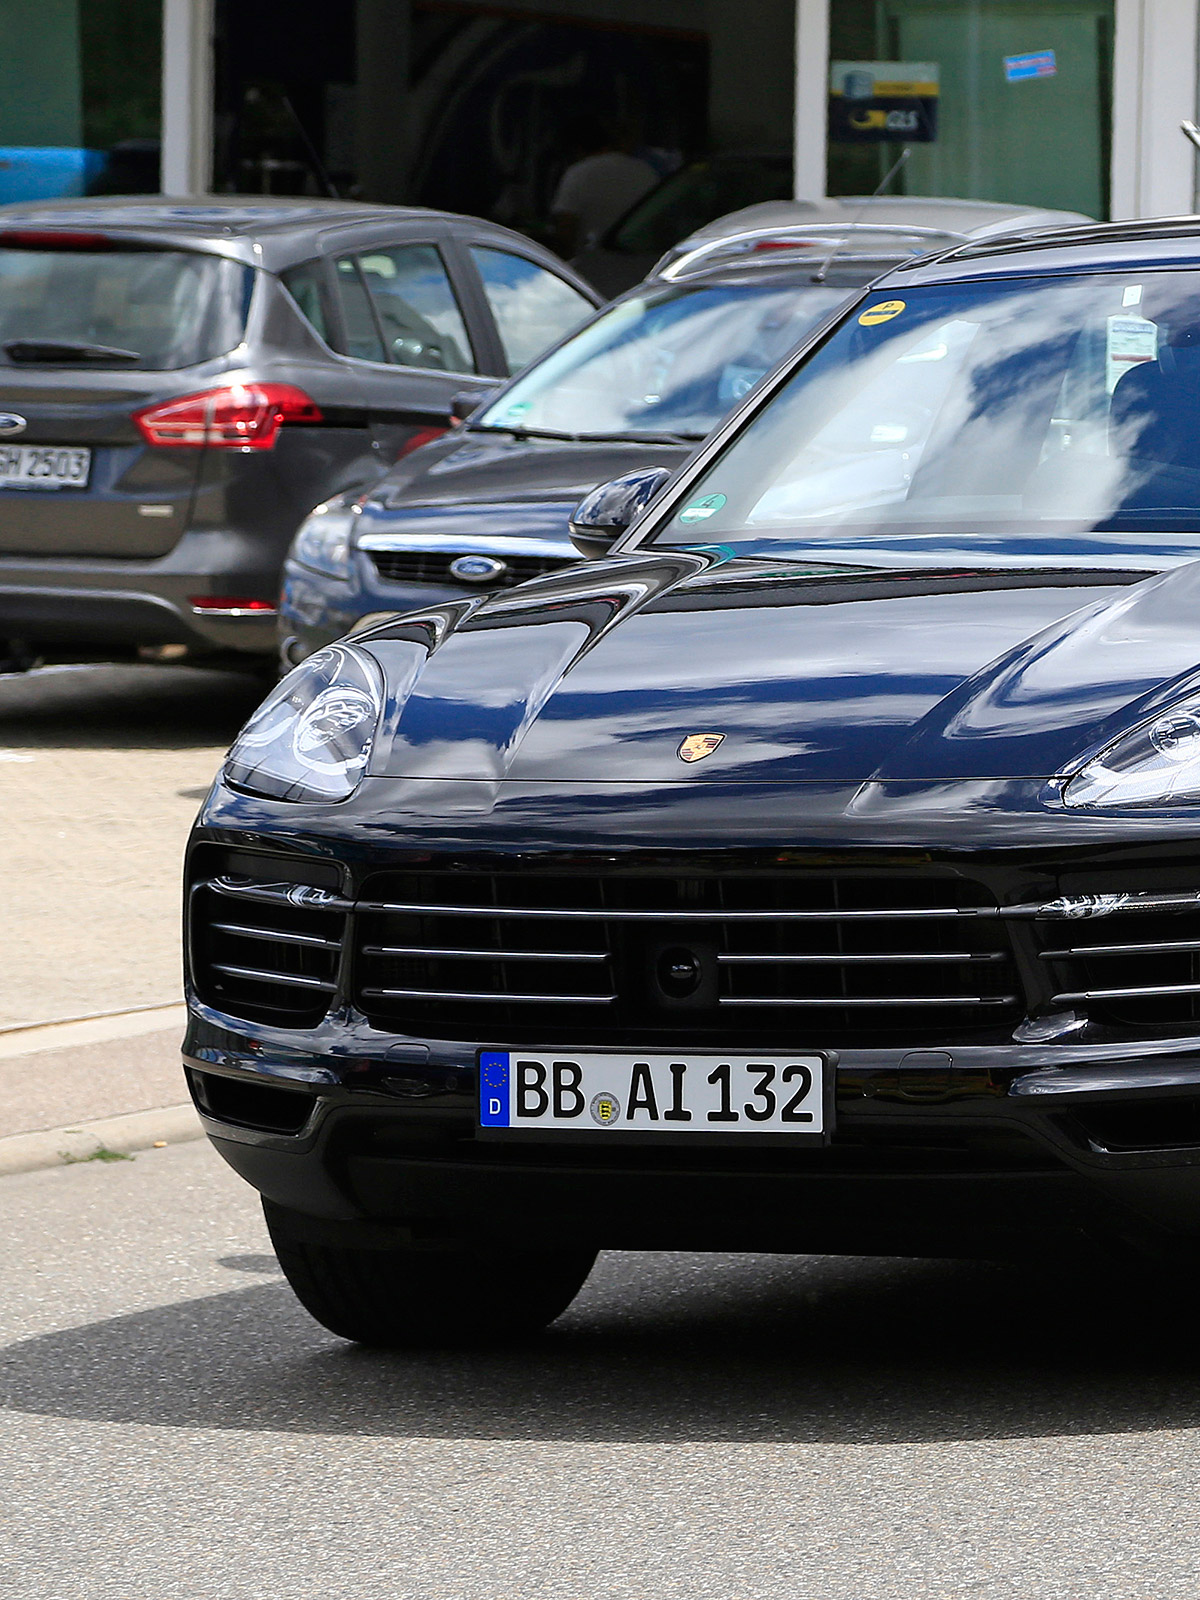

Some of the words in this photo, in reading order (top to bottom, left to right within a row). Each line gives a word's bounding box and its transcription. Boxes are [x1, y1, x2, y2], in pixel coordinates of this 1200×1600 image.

[489, 1098, 502, 1115] D
[516, 1060, 586, 1119] BB
[626, 1063, 693, 1121] AI
[707, 1064, 814, 1123] 132
